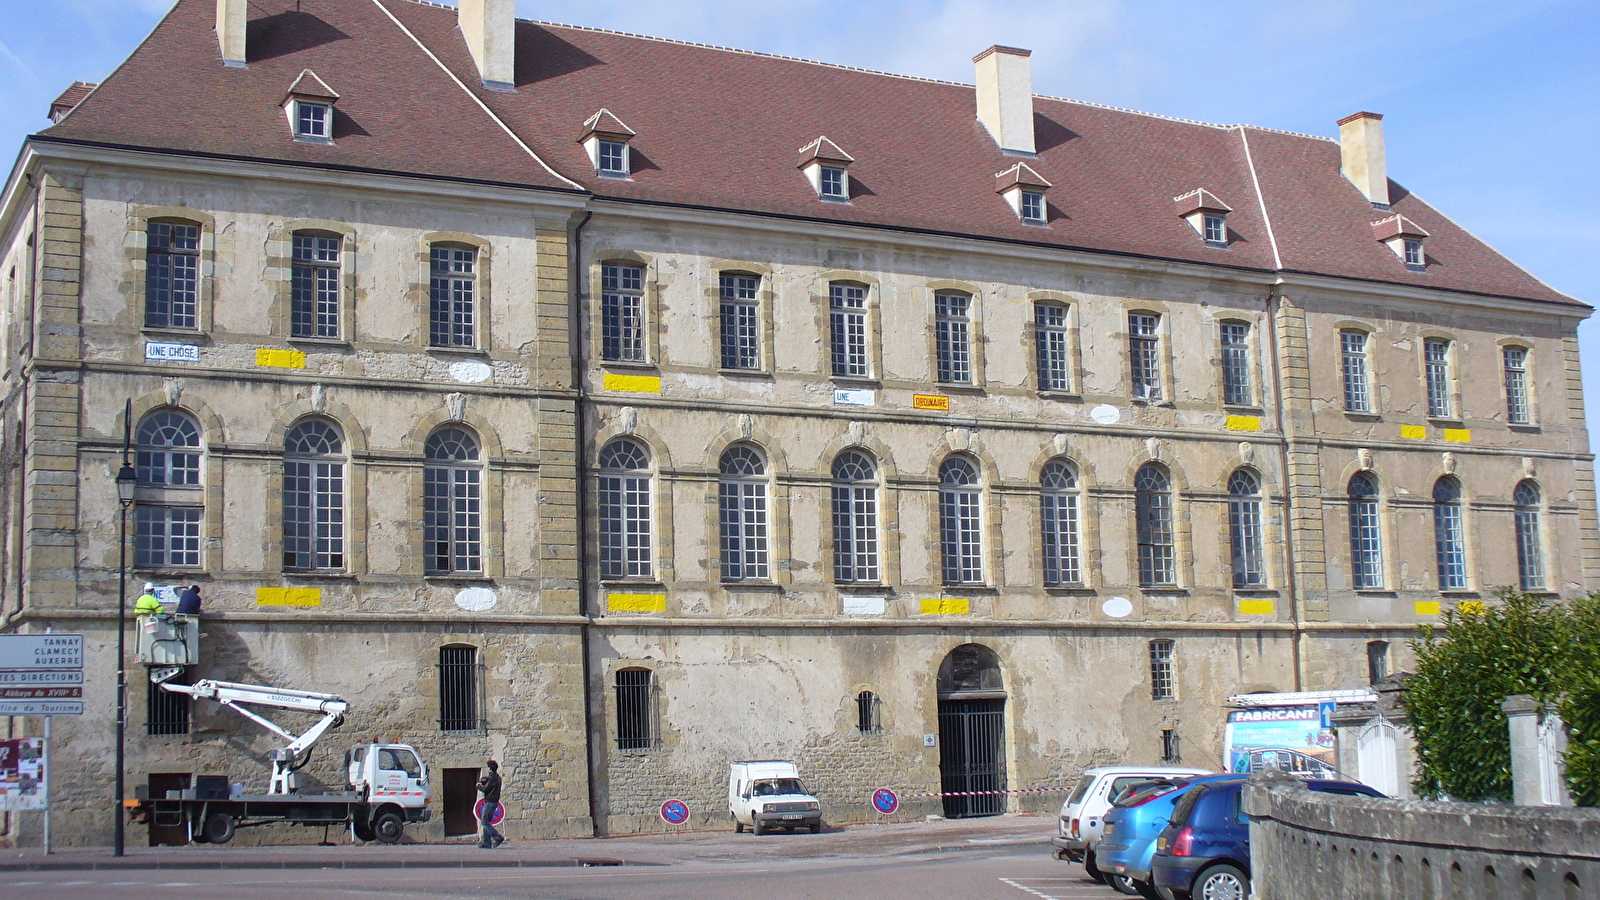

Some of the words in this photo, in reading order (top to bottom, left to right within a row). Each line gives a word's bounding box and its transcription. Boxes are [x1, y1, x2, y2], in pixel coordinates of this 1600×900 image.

[149, 346, 166, 356] UNE
[168, 347, 195, 358] CHOSE
[836, 392, 850, 401] UNE
[915, 397, 948, 408] ORDINAIRE
[21, 673, 80, 681] DIRECTIONS
[5, 689, 32, 698] Abbaye
[34, 689, 45, 697] du
[41, 704, 80, 712] Tourisme
[1235, 709, 1316, 722] FABRICANT
